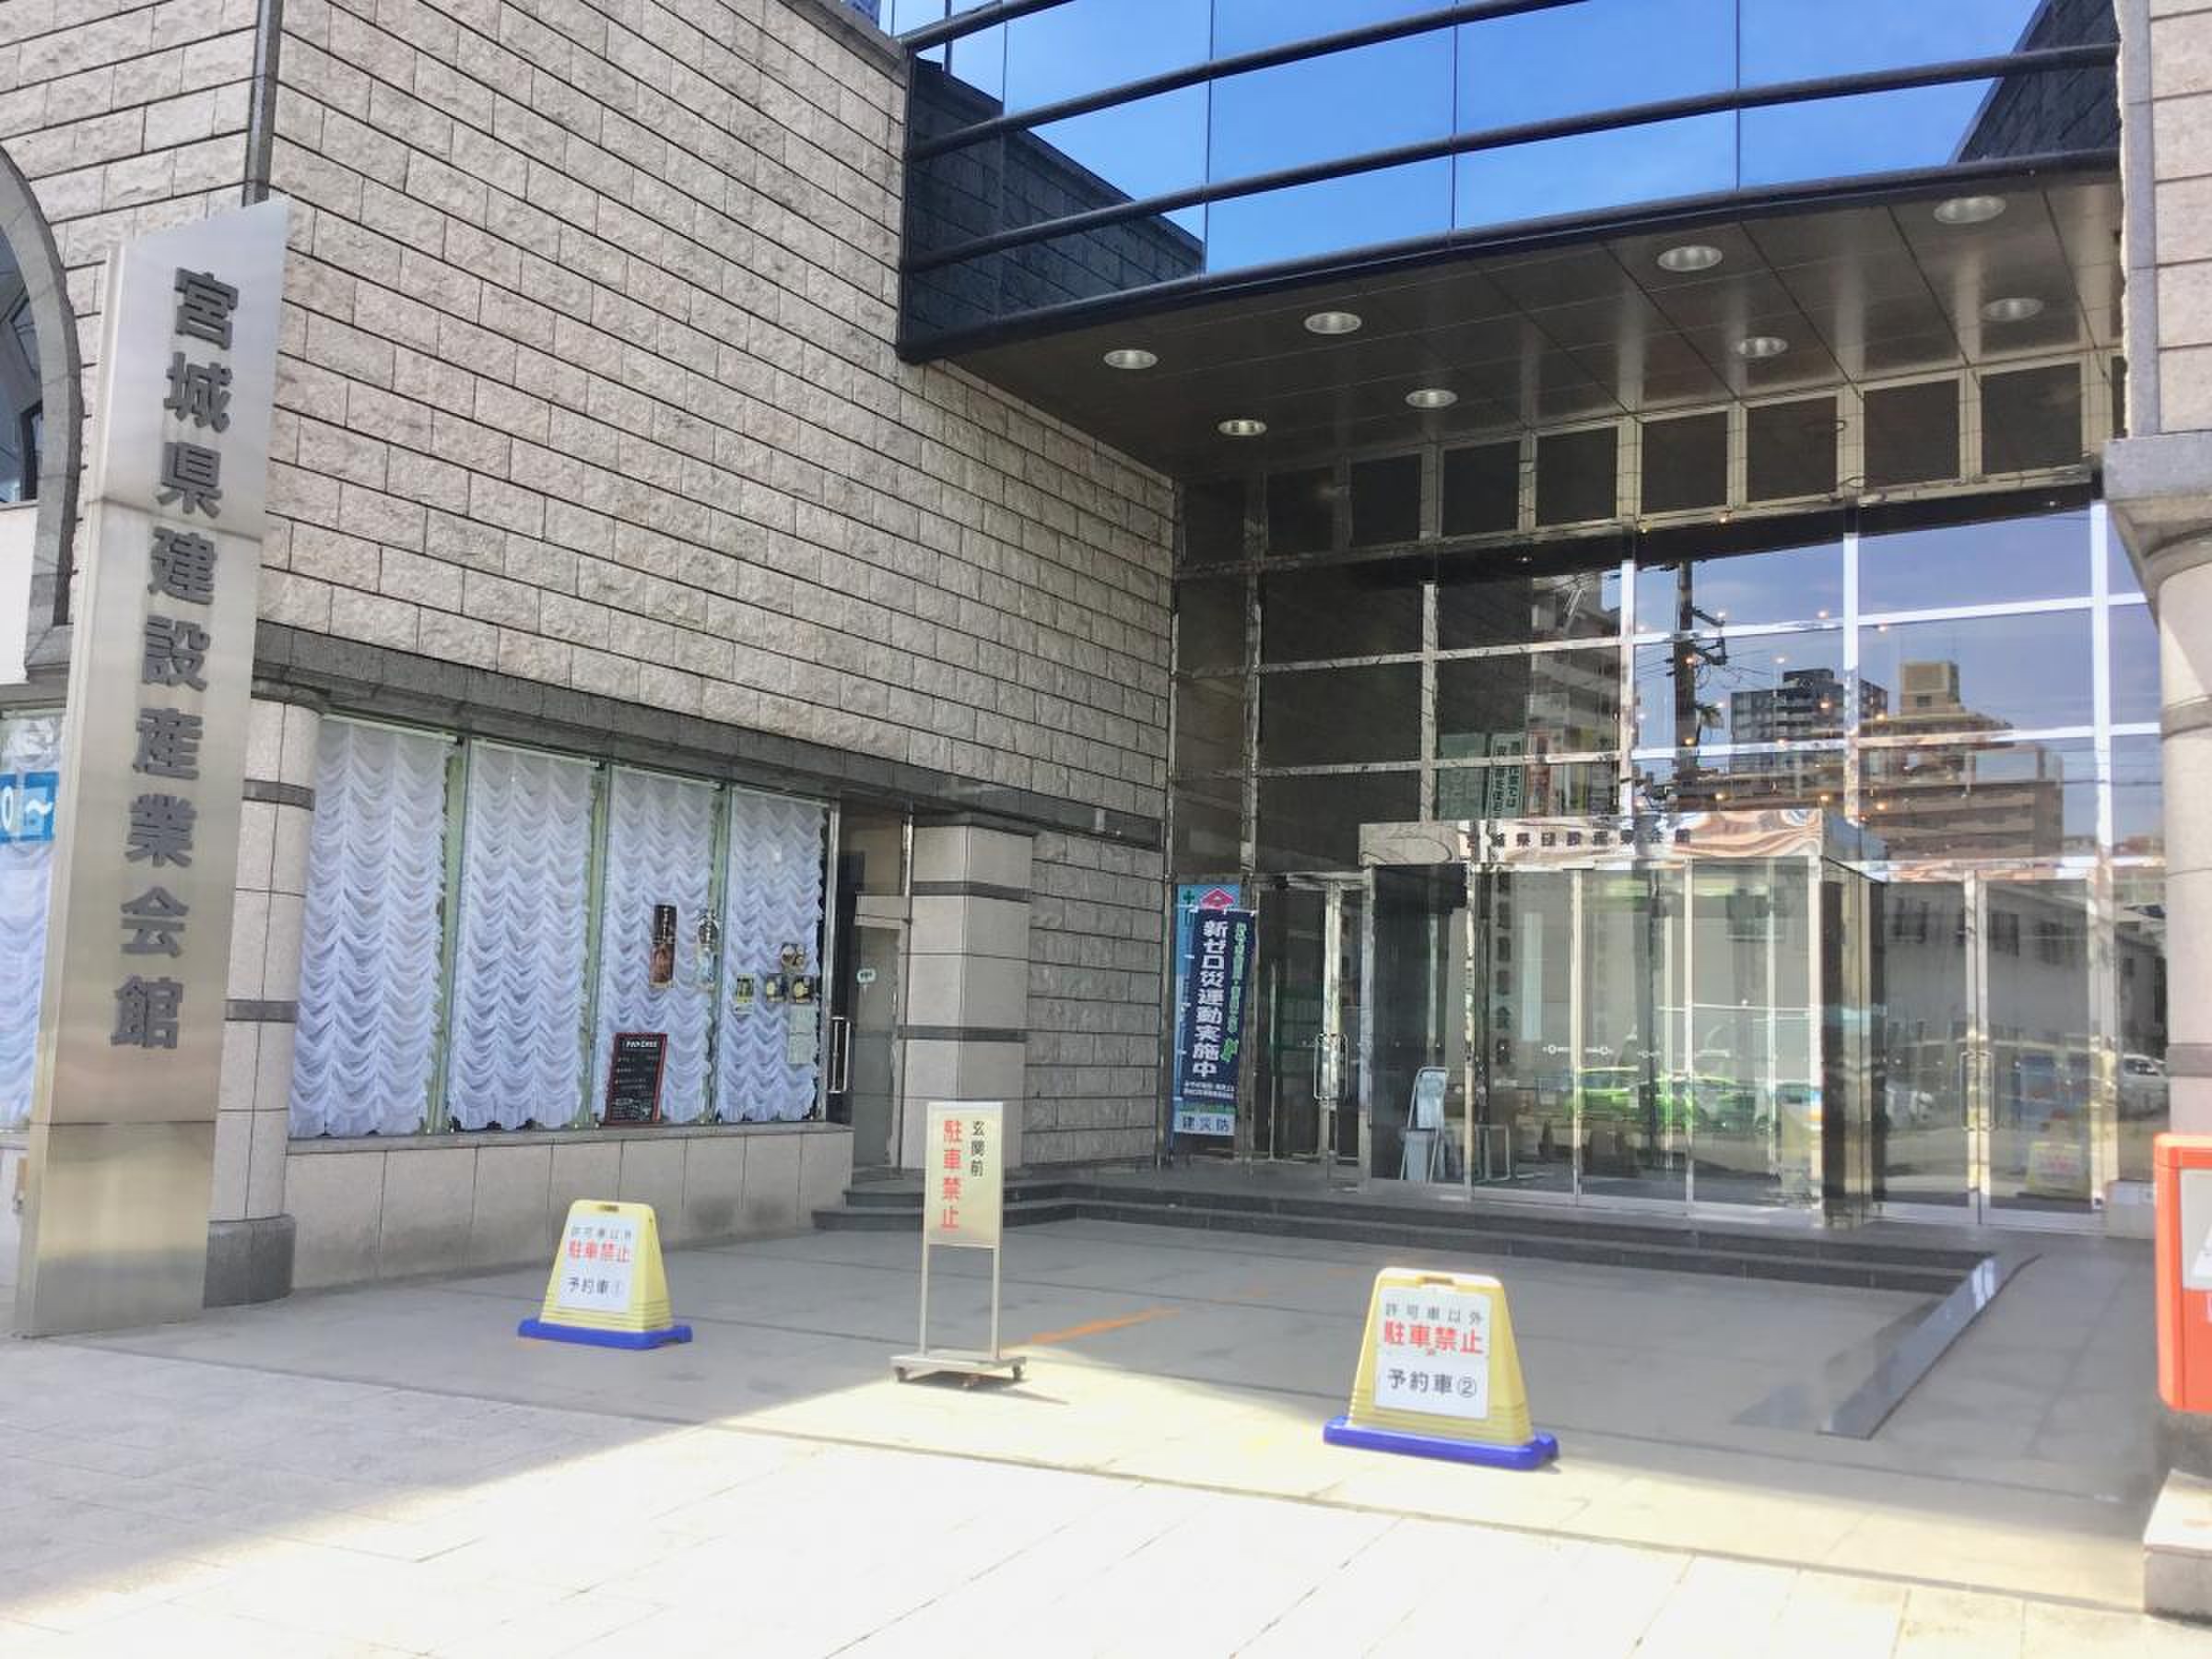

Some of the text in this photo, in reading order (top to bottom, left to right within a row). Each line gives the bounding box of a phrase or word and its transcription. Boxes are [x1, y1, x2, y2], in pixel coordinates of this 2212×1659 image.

[111, 266, 240, 1050] 宮城県建設産業会館
[1193, 920, 1229, 1077] 新ゼロ災運動実施中
[942, 1120, 962, 1229] 駐車禁止
[971, 1120, 985, 1177] 玄関前
[1384, 1321, 1484, 1355] 駐車禁止
[1385, 1302, 1483, 1324] 許可車以外
[1387, 1368, 1477, 1398] 予約車②
